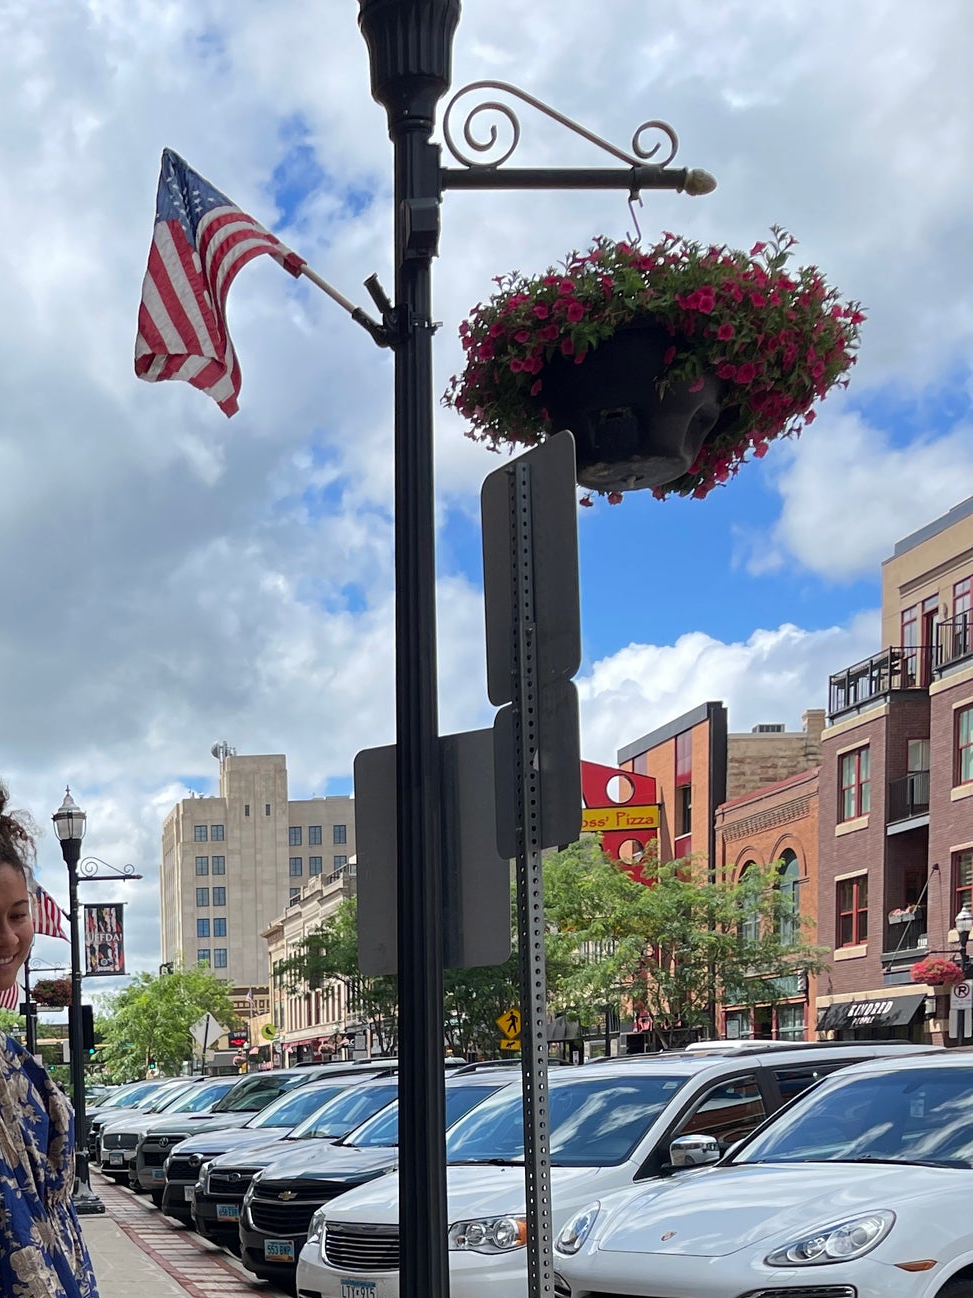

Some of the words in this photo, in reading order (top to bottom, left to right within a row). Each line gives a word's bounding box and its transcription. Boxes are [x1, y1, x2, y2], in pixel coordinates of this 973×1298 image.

[582, 816, 609, 828] oss'
[615, 811, 654, 826] Pizza
[847, 1001, 894, 1017] KINDRED
[851, 1015, 876, 1026] PEOPLE
[267, 1244, 278, 1255] 553
